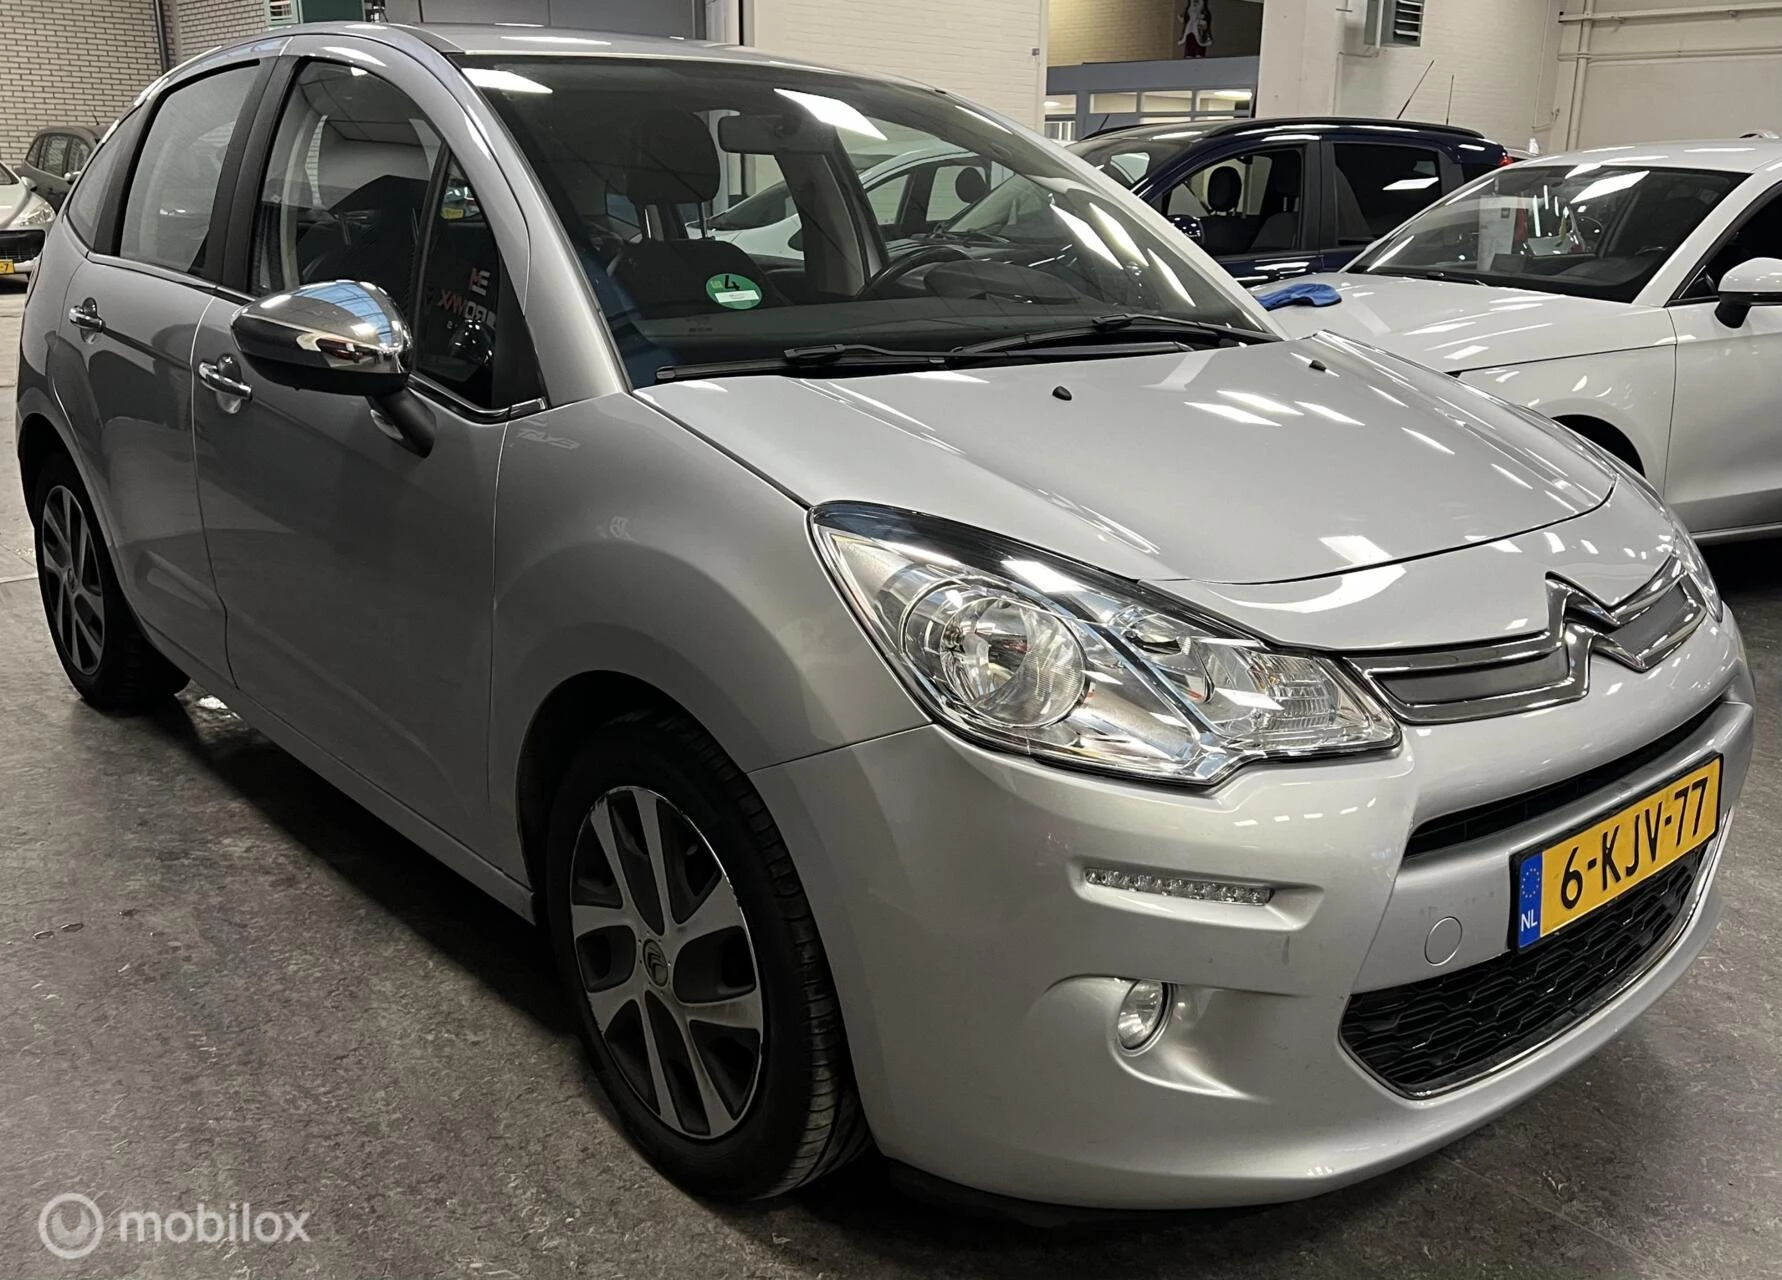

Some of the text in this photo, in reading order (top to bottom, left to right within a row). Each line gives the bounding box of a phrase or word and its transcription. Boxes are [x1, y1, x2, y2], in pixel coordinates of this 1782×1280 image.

[724, 274, 740, 291] 4
[1561, 777, 1708, 909] 6-KJV-77
[1521, 910, 1538, 932] NL
